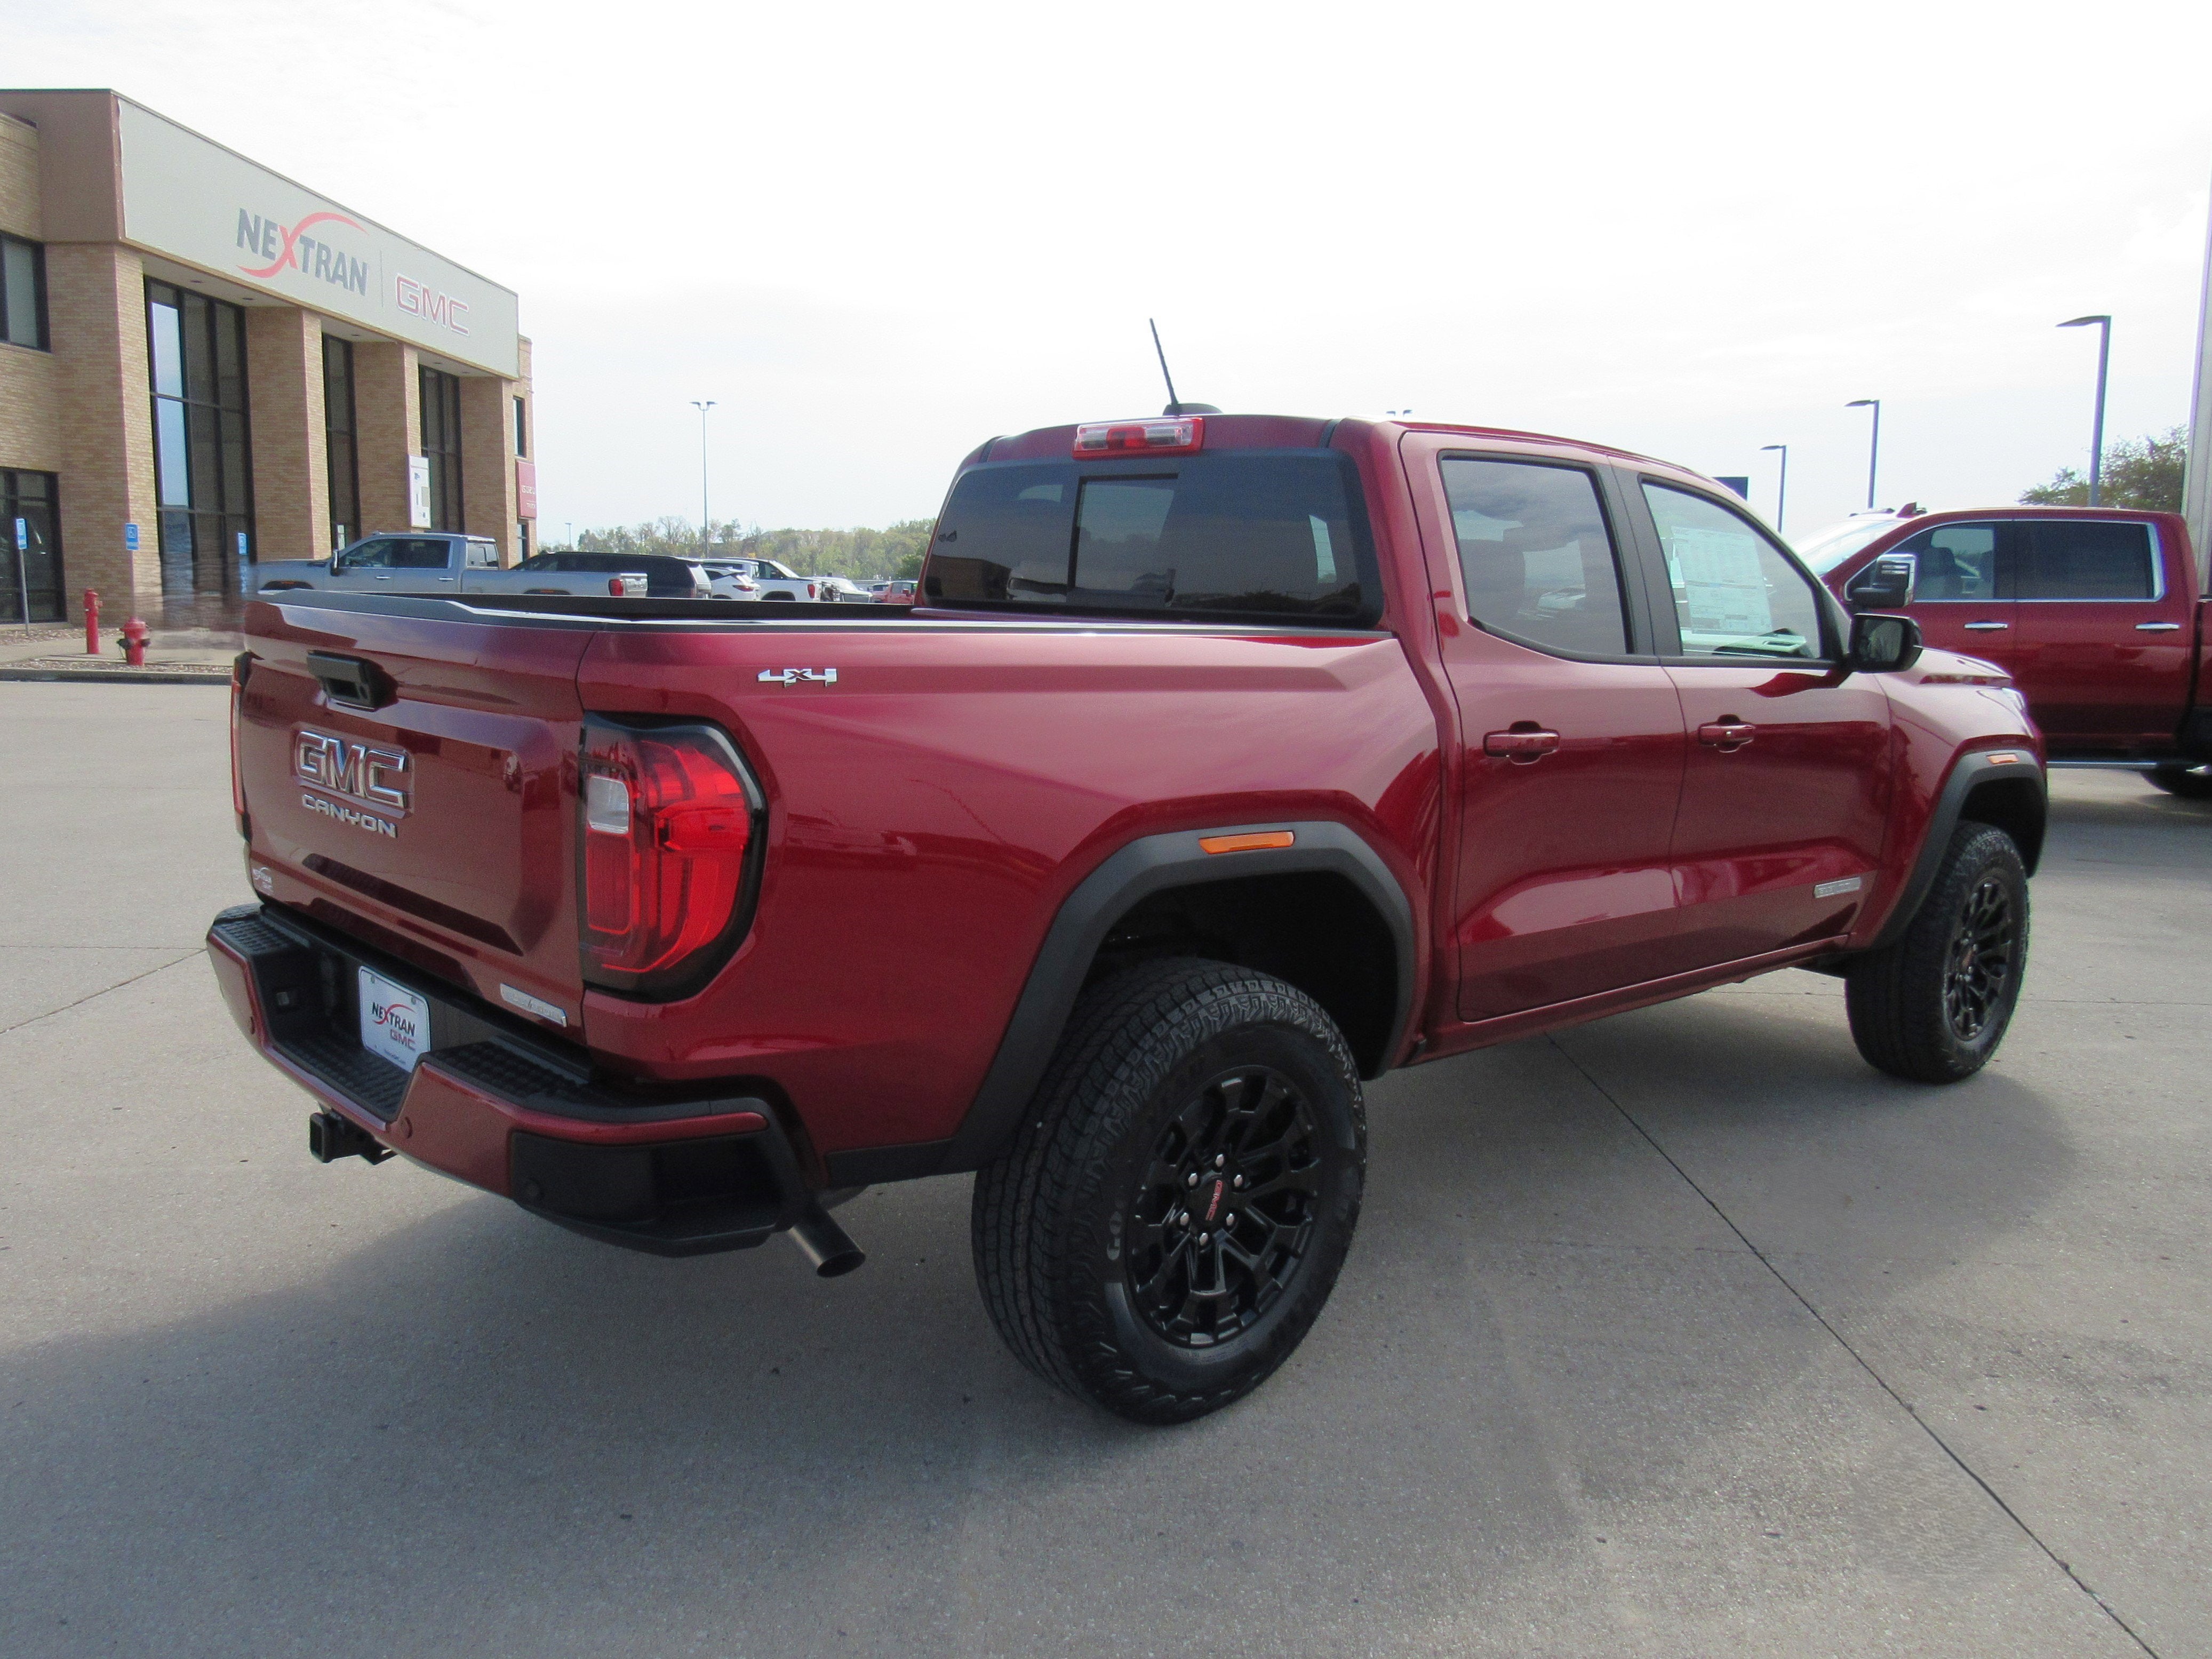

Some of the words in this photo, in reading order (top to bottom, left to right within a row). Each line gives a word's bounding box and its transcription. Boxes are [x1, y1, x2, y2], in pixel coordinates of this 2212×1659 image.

[236, 208, 369, 296] NEXTRAN
[395, 273, 470, 336] GMC
[296, 730, 407, 809] GMC
[302, 794, 397, 839] CANYON
[372, 1002, 416, 1036] NEXTRAN
[390, 1029, 416, 1051] GMC
[1205, 1180, 1223, 1221] GMC
